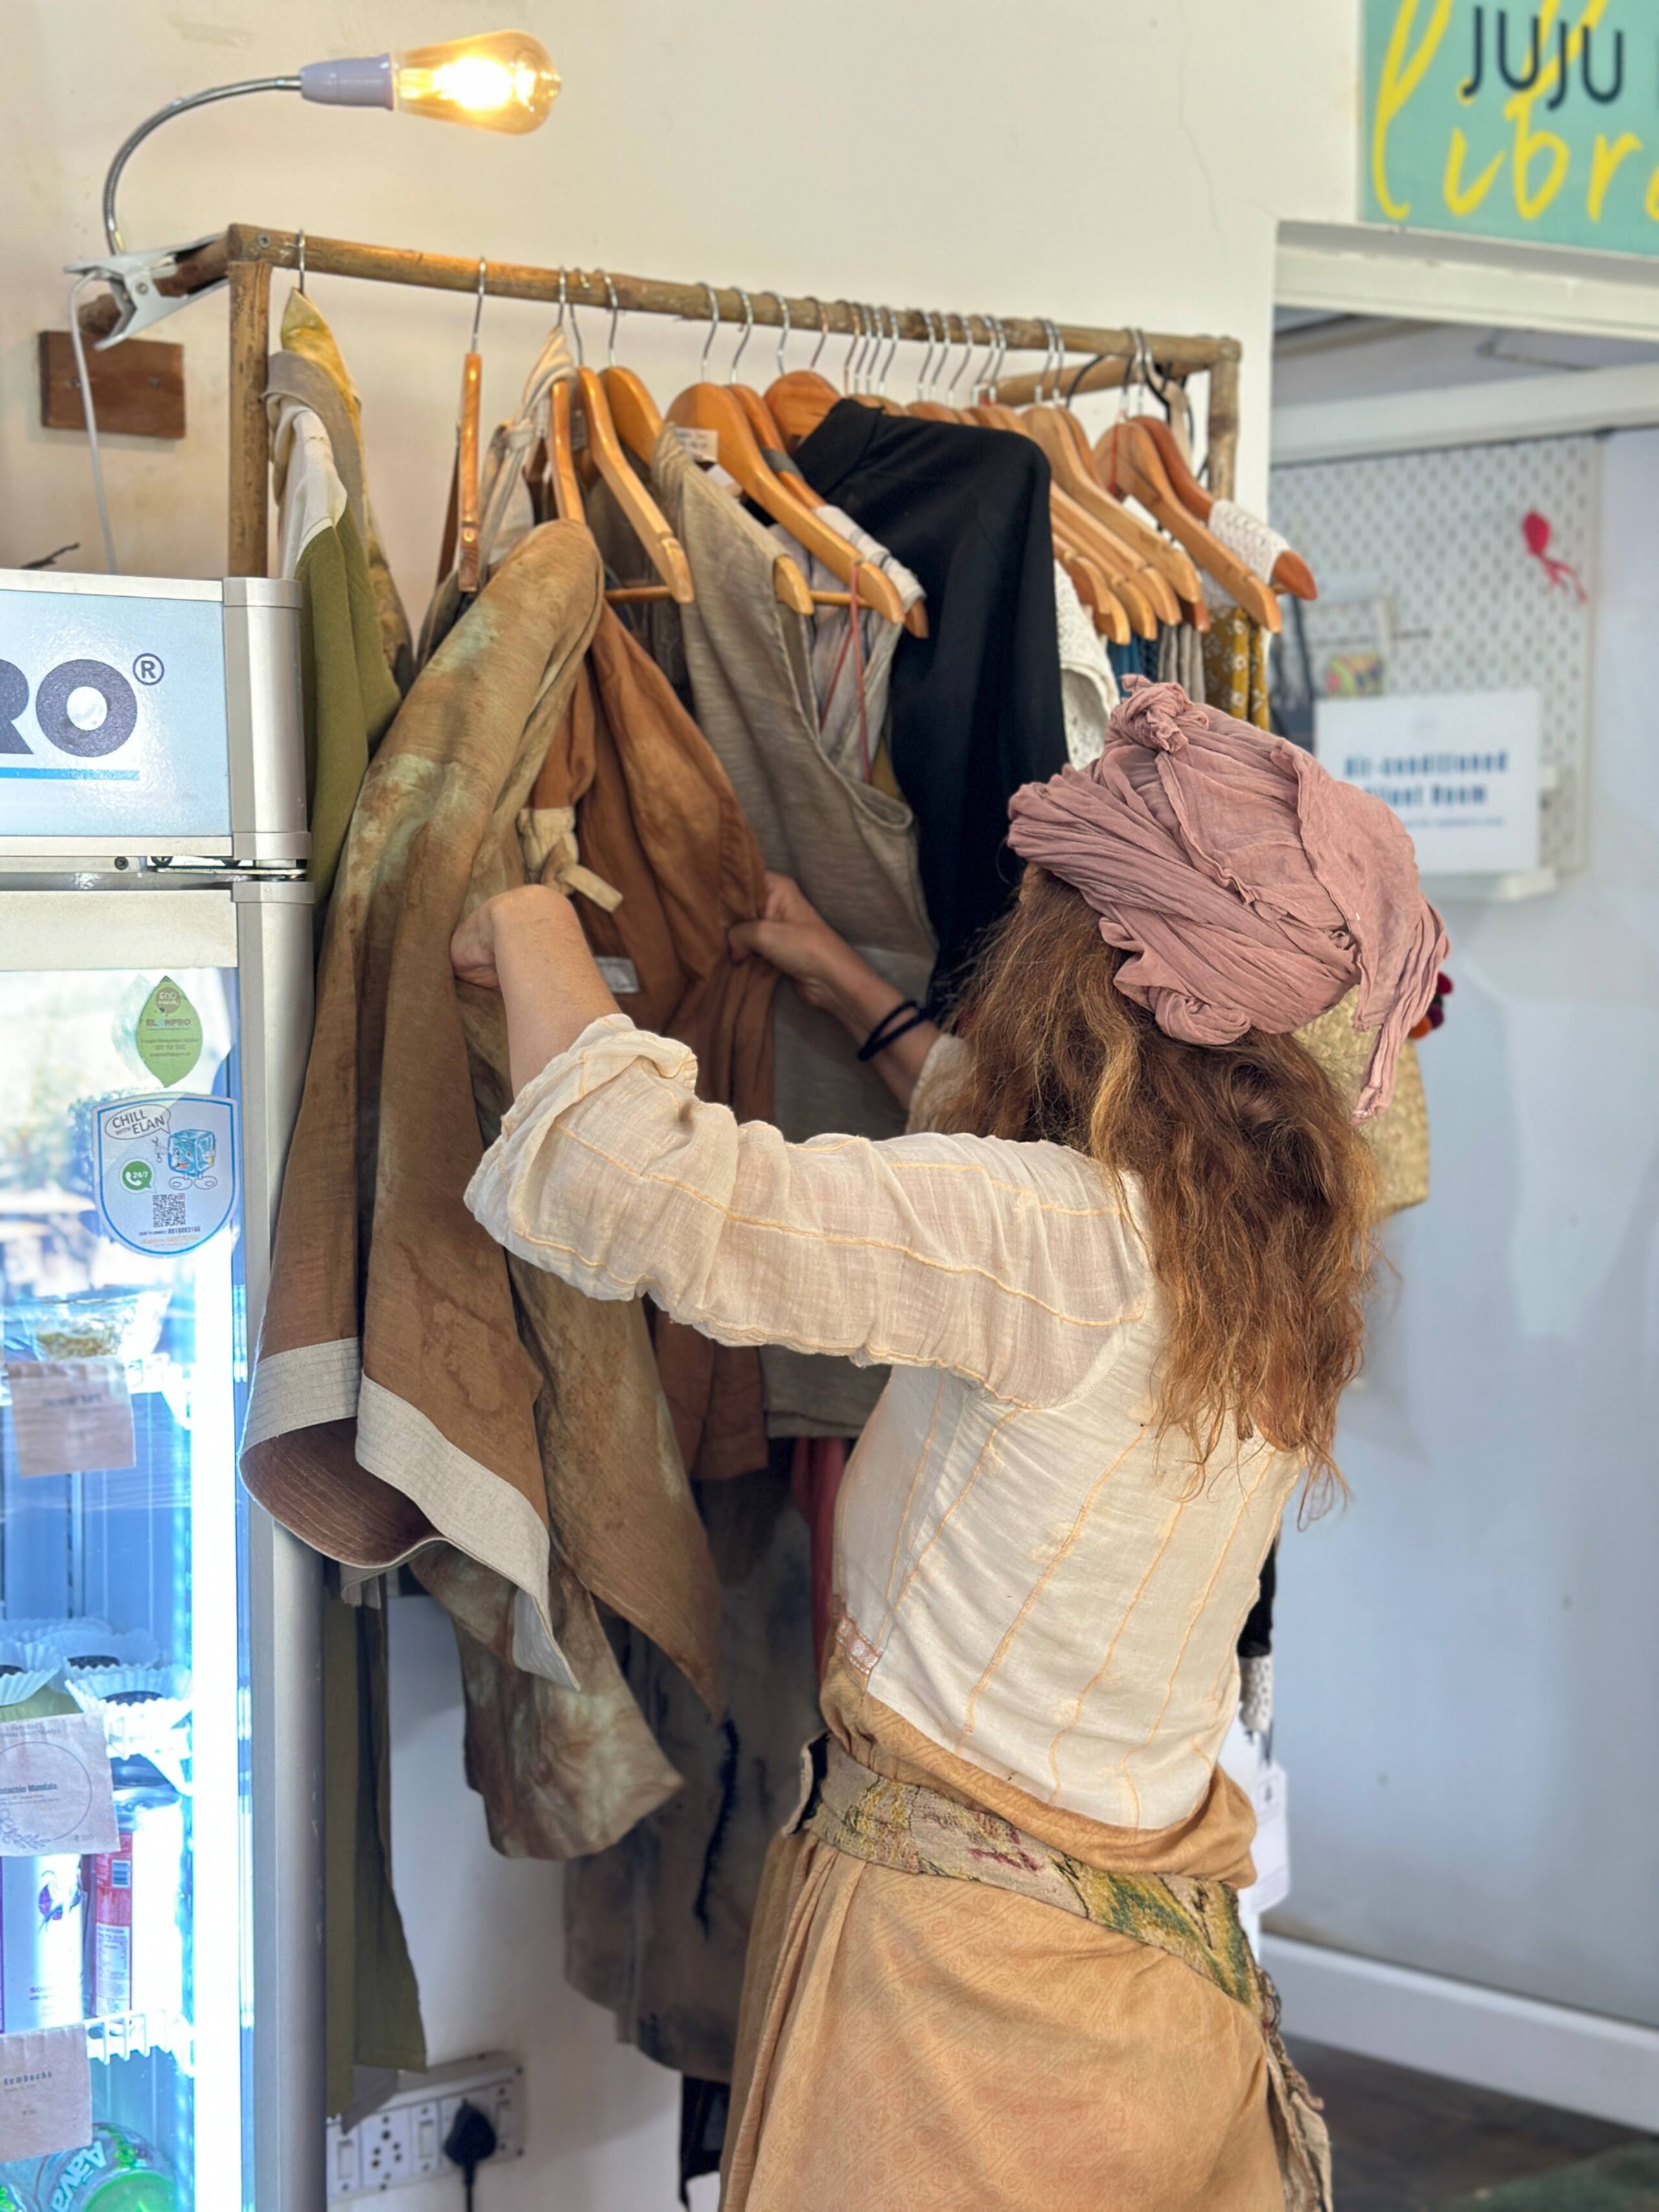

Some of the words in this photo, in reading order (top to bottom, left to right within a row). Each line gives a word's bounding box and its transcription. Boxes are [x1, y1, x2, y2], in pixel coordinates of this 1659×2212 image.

[1461, 5, 1624, 111] JUJU
[1371, 0, 1659, 223] libr
[112, 1109, 148, 1128] CHILL
[132, 1115, 166, 1135] ELAN
